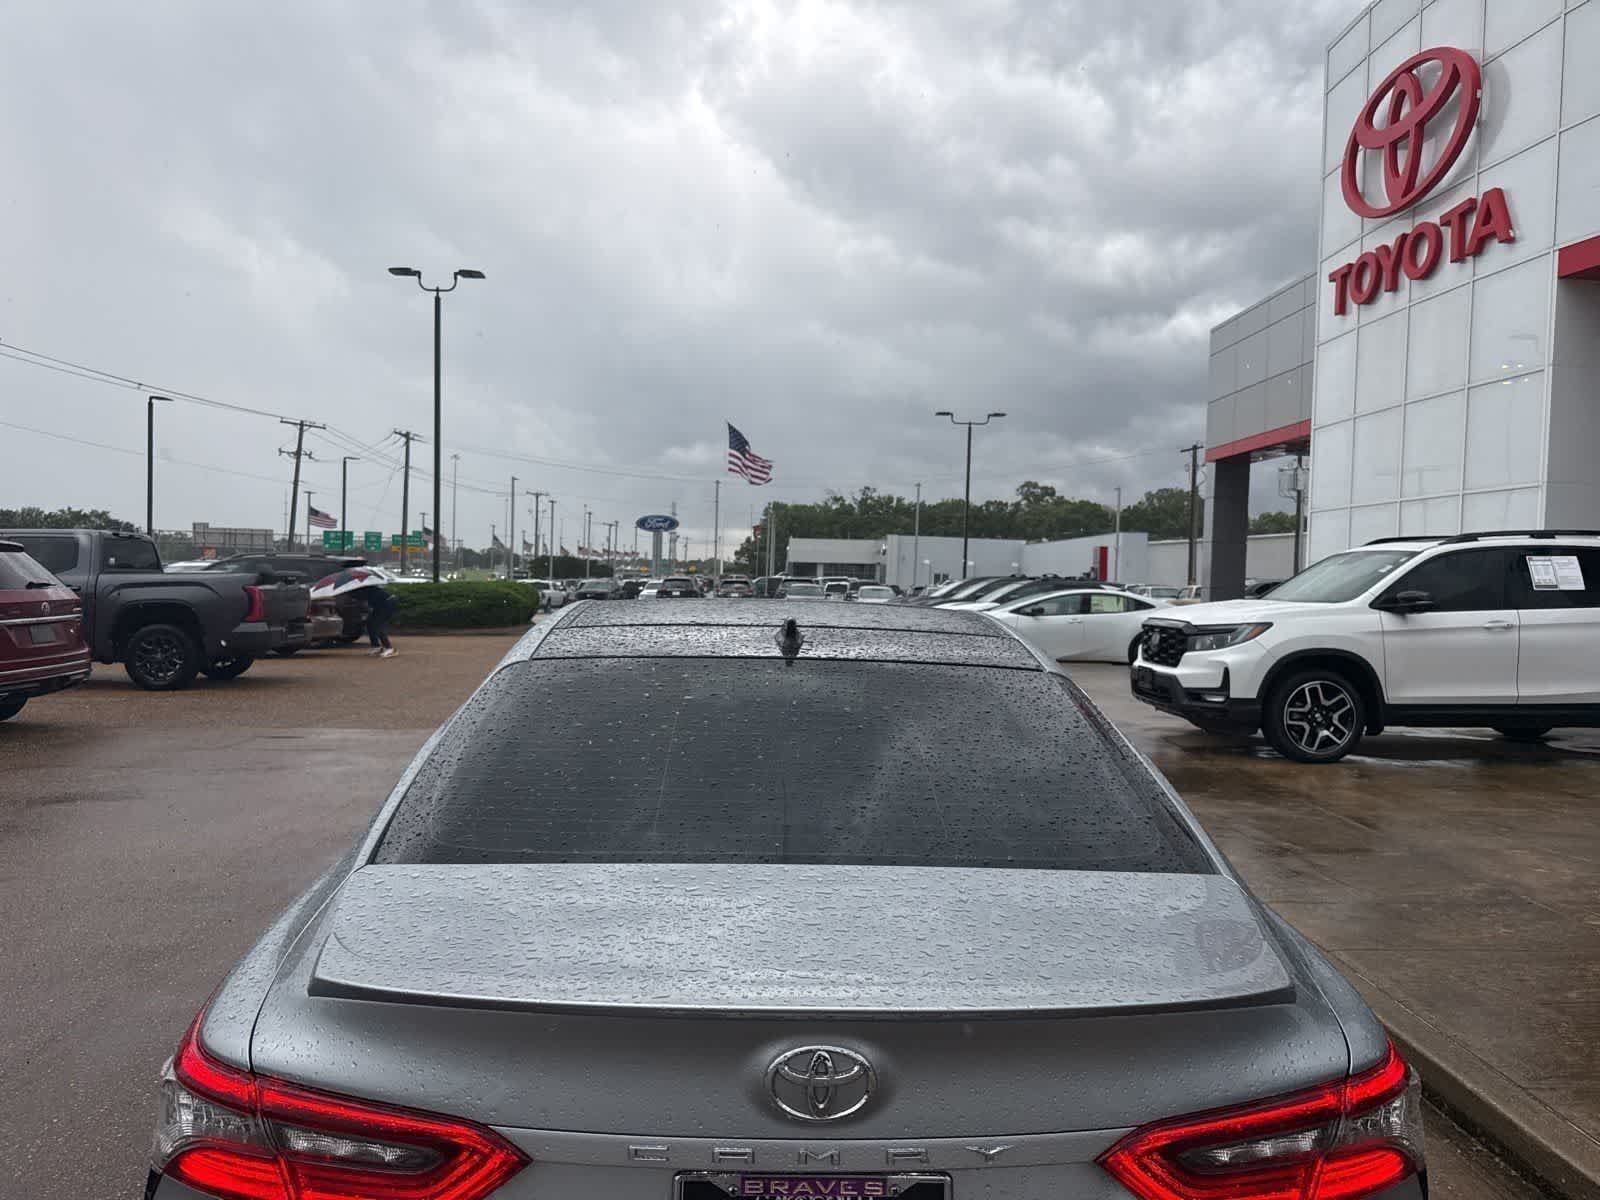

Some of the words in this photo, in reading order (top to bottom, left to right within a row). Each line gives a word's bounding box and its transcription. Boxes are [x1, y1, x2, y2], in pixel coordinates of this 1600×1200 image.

[1329, 187, 1515, 316] TOYOTA
[628, 1144, 1016, 1165] CAMRY
[744, 1180, 884, 1196] BRAVES
